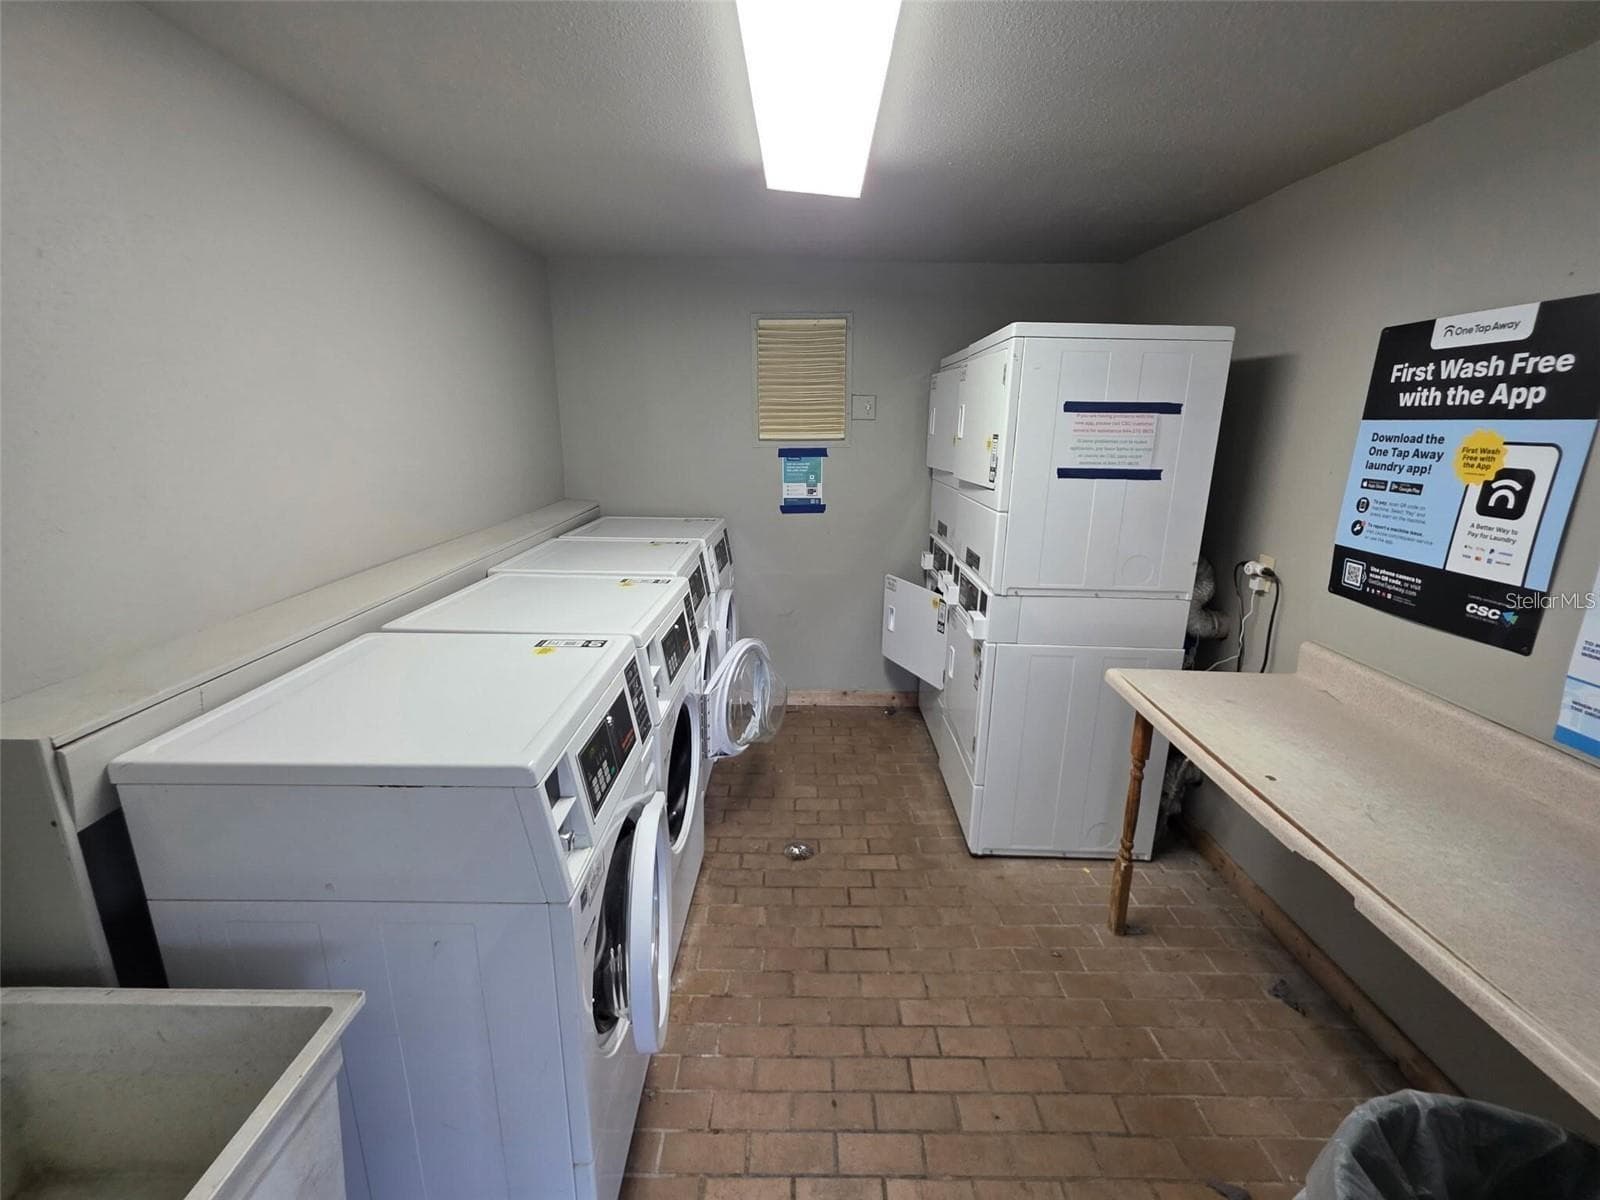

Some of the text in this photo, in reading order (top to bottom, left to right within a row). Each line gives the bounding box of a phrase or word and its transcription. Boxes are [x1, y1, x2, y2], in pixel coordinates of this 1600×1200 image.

[1455, 320, 1522, 336] One Tap Away
[1390, 352, 1576, 383] First Wash Free
[1399, 383, 1548, 410] with the App
[1371, 432, 1446, 445] Download the
[1368, 446, 1444, 462] One Tap Away
[1461, 446, 1501, 455] First Wash
[1365, 460, 1433, 476] laundry app!
[1476, 463, 1492, 471] App
[1476, 523, 1495, 532] Better
[1496, 525, 1510, 535] Way
[1511, 528, 1519, 536] to
[1467, 530, 1517, 545] Pay for Laundry
[1395, 573, 1415, 583] camera
[1465, 603, 1501, 620] CSC
